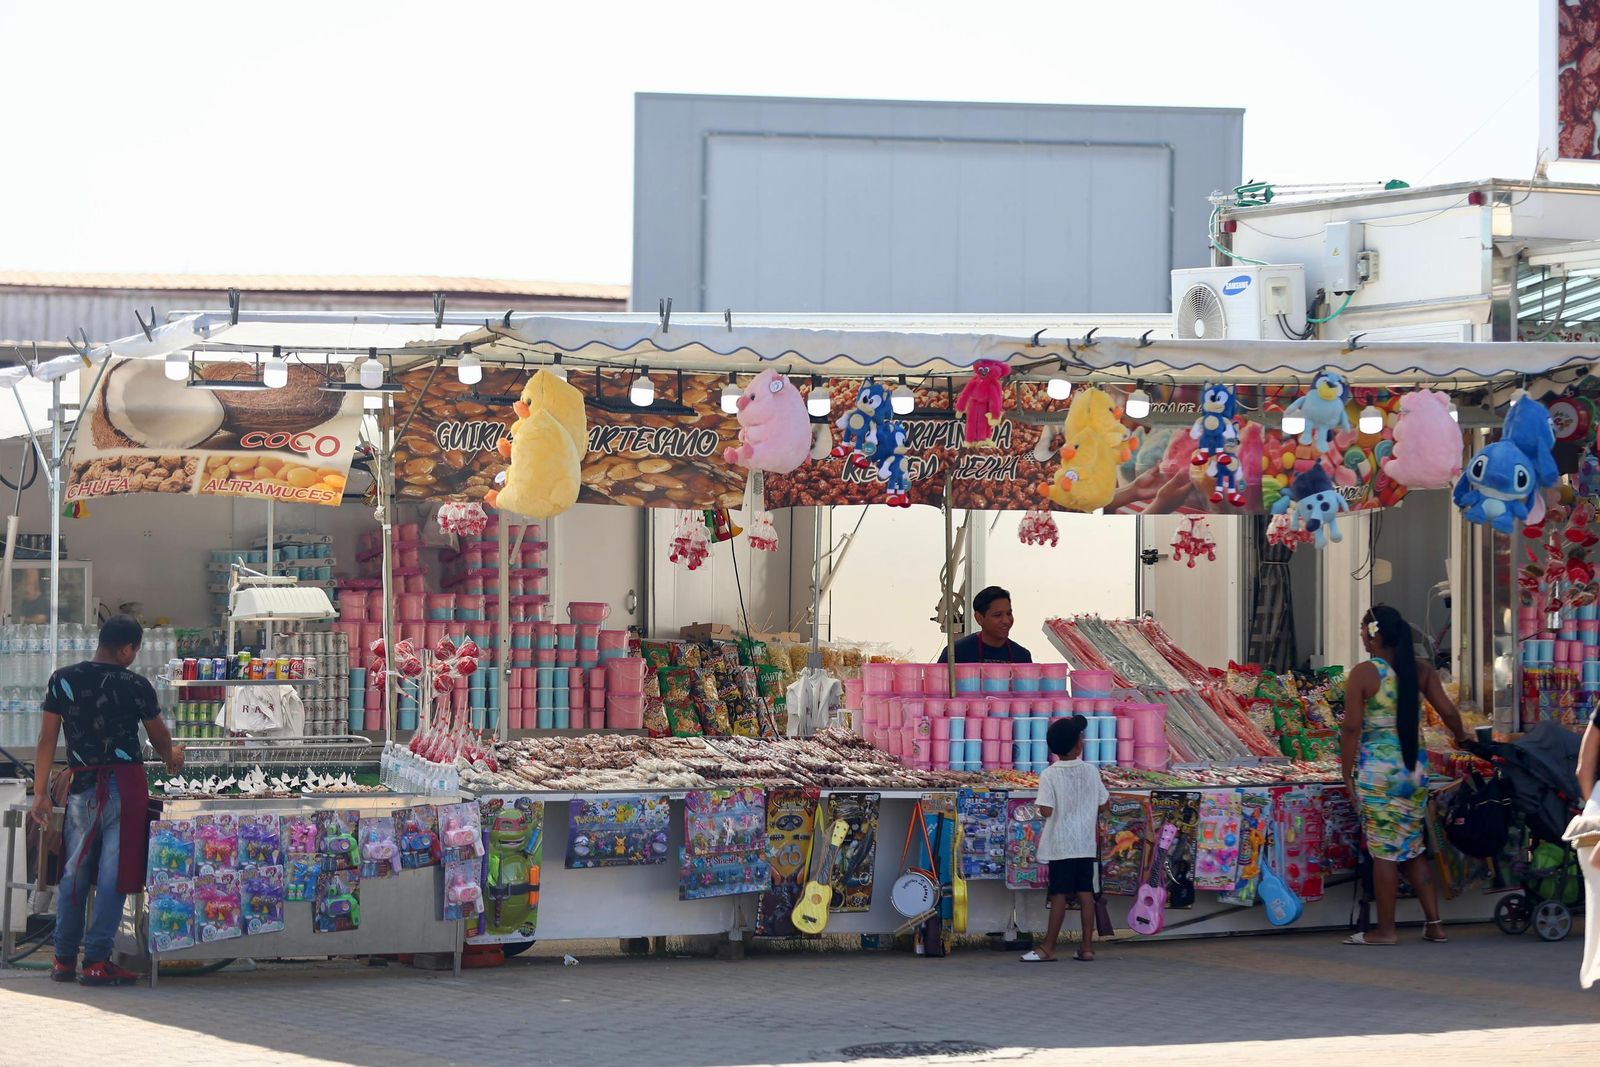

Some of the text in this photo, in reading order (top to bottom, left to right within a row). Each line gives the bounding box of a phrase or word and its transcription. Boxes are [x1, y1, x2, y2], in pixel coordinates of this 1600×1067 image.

[240, 431, 341, 458] COCO
[587, 425, 719, 456] ARTESANO
[952, 454, 1020, 482] HECHA
[67, 477, 129, 499] CHUFA
[203, 479, 336, 502] ALTRAMUCES
